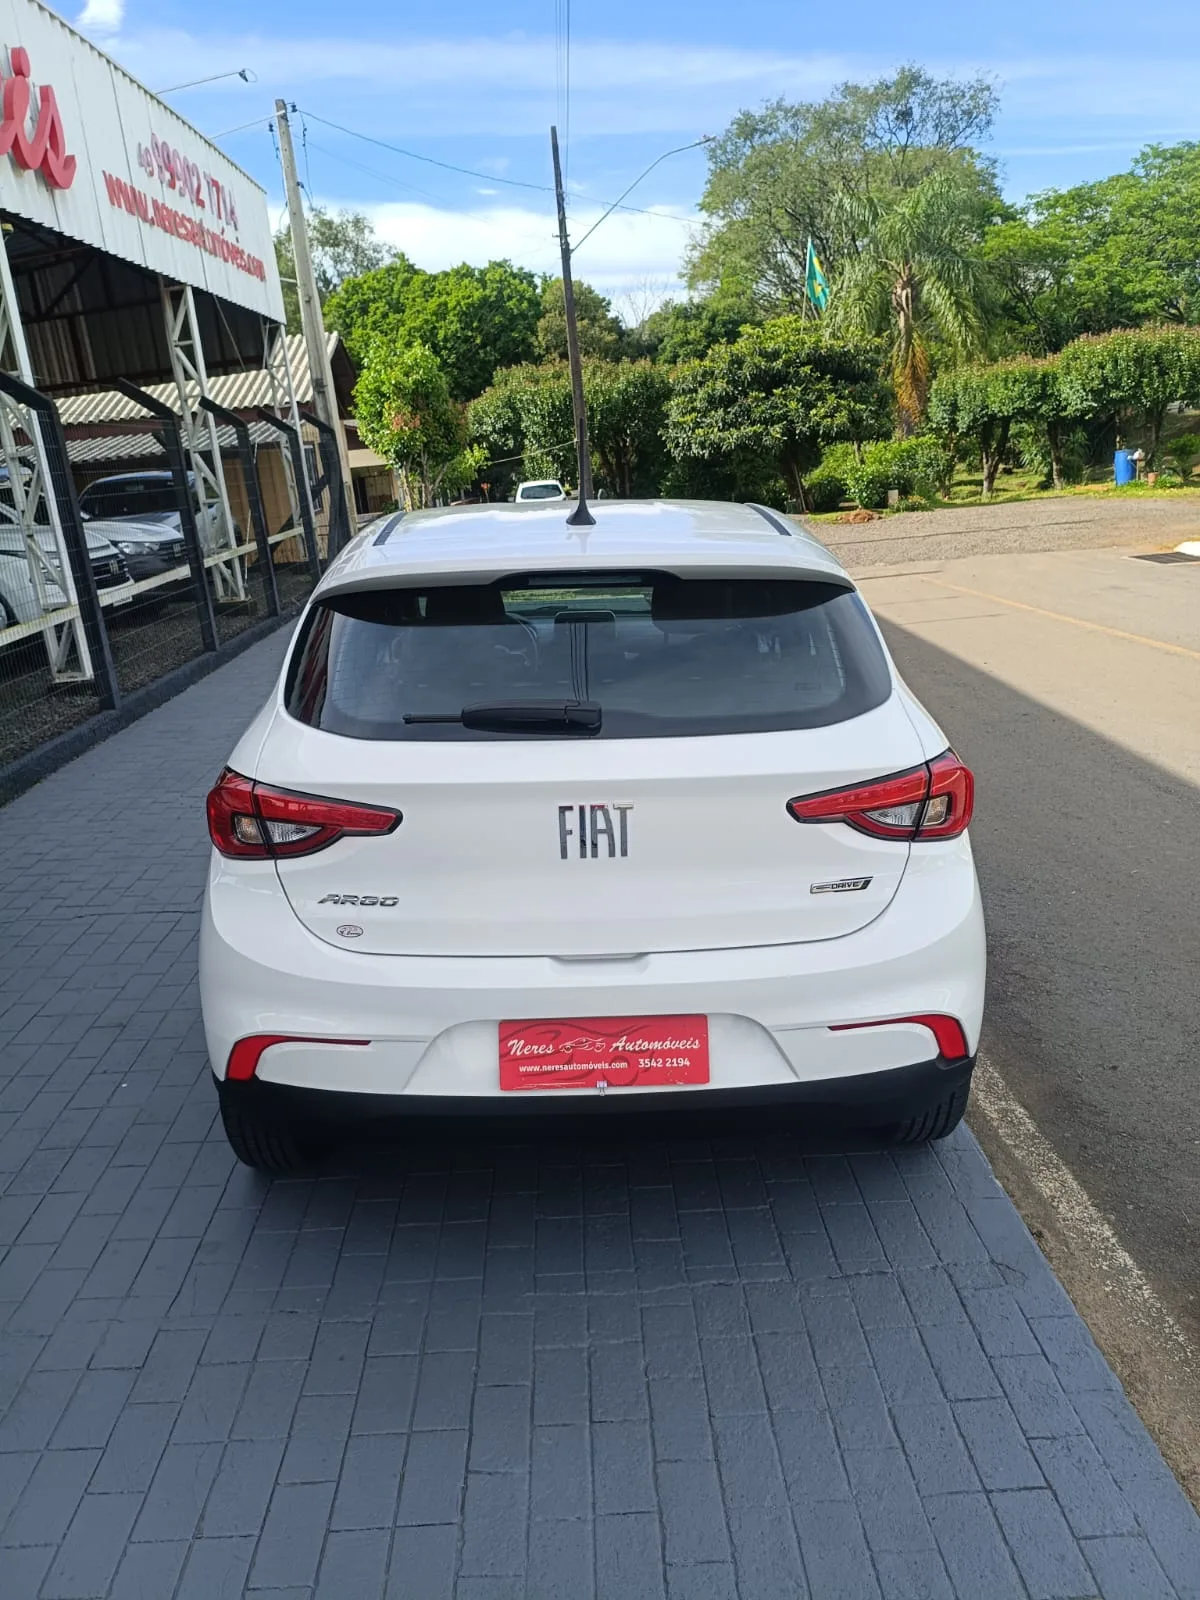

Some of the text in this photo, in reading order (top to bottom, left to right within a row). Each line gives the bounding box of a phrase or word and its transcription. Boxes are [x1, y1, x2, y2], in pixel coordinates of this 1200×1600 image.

[0, 45, 77, 190] is
[558, 803, 634, 859] FIAT
[831, 880, 863, 890] DRIVE
[317, 893, 399, 907] ARGO
[507, 1035, 701, 1056] Neres Automóveis
[638, 1058, 663, 1068] 3542
[665, 1058, 691, 1068] 2194
